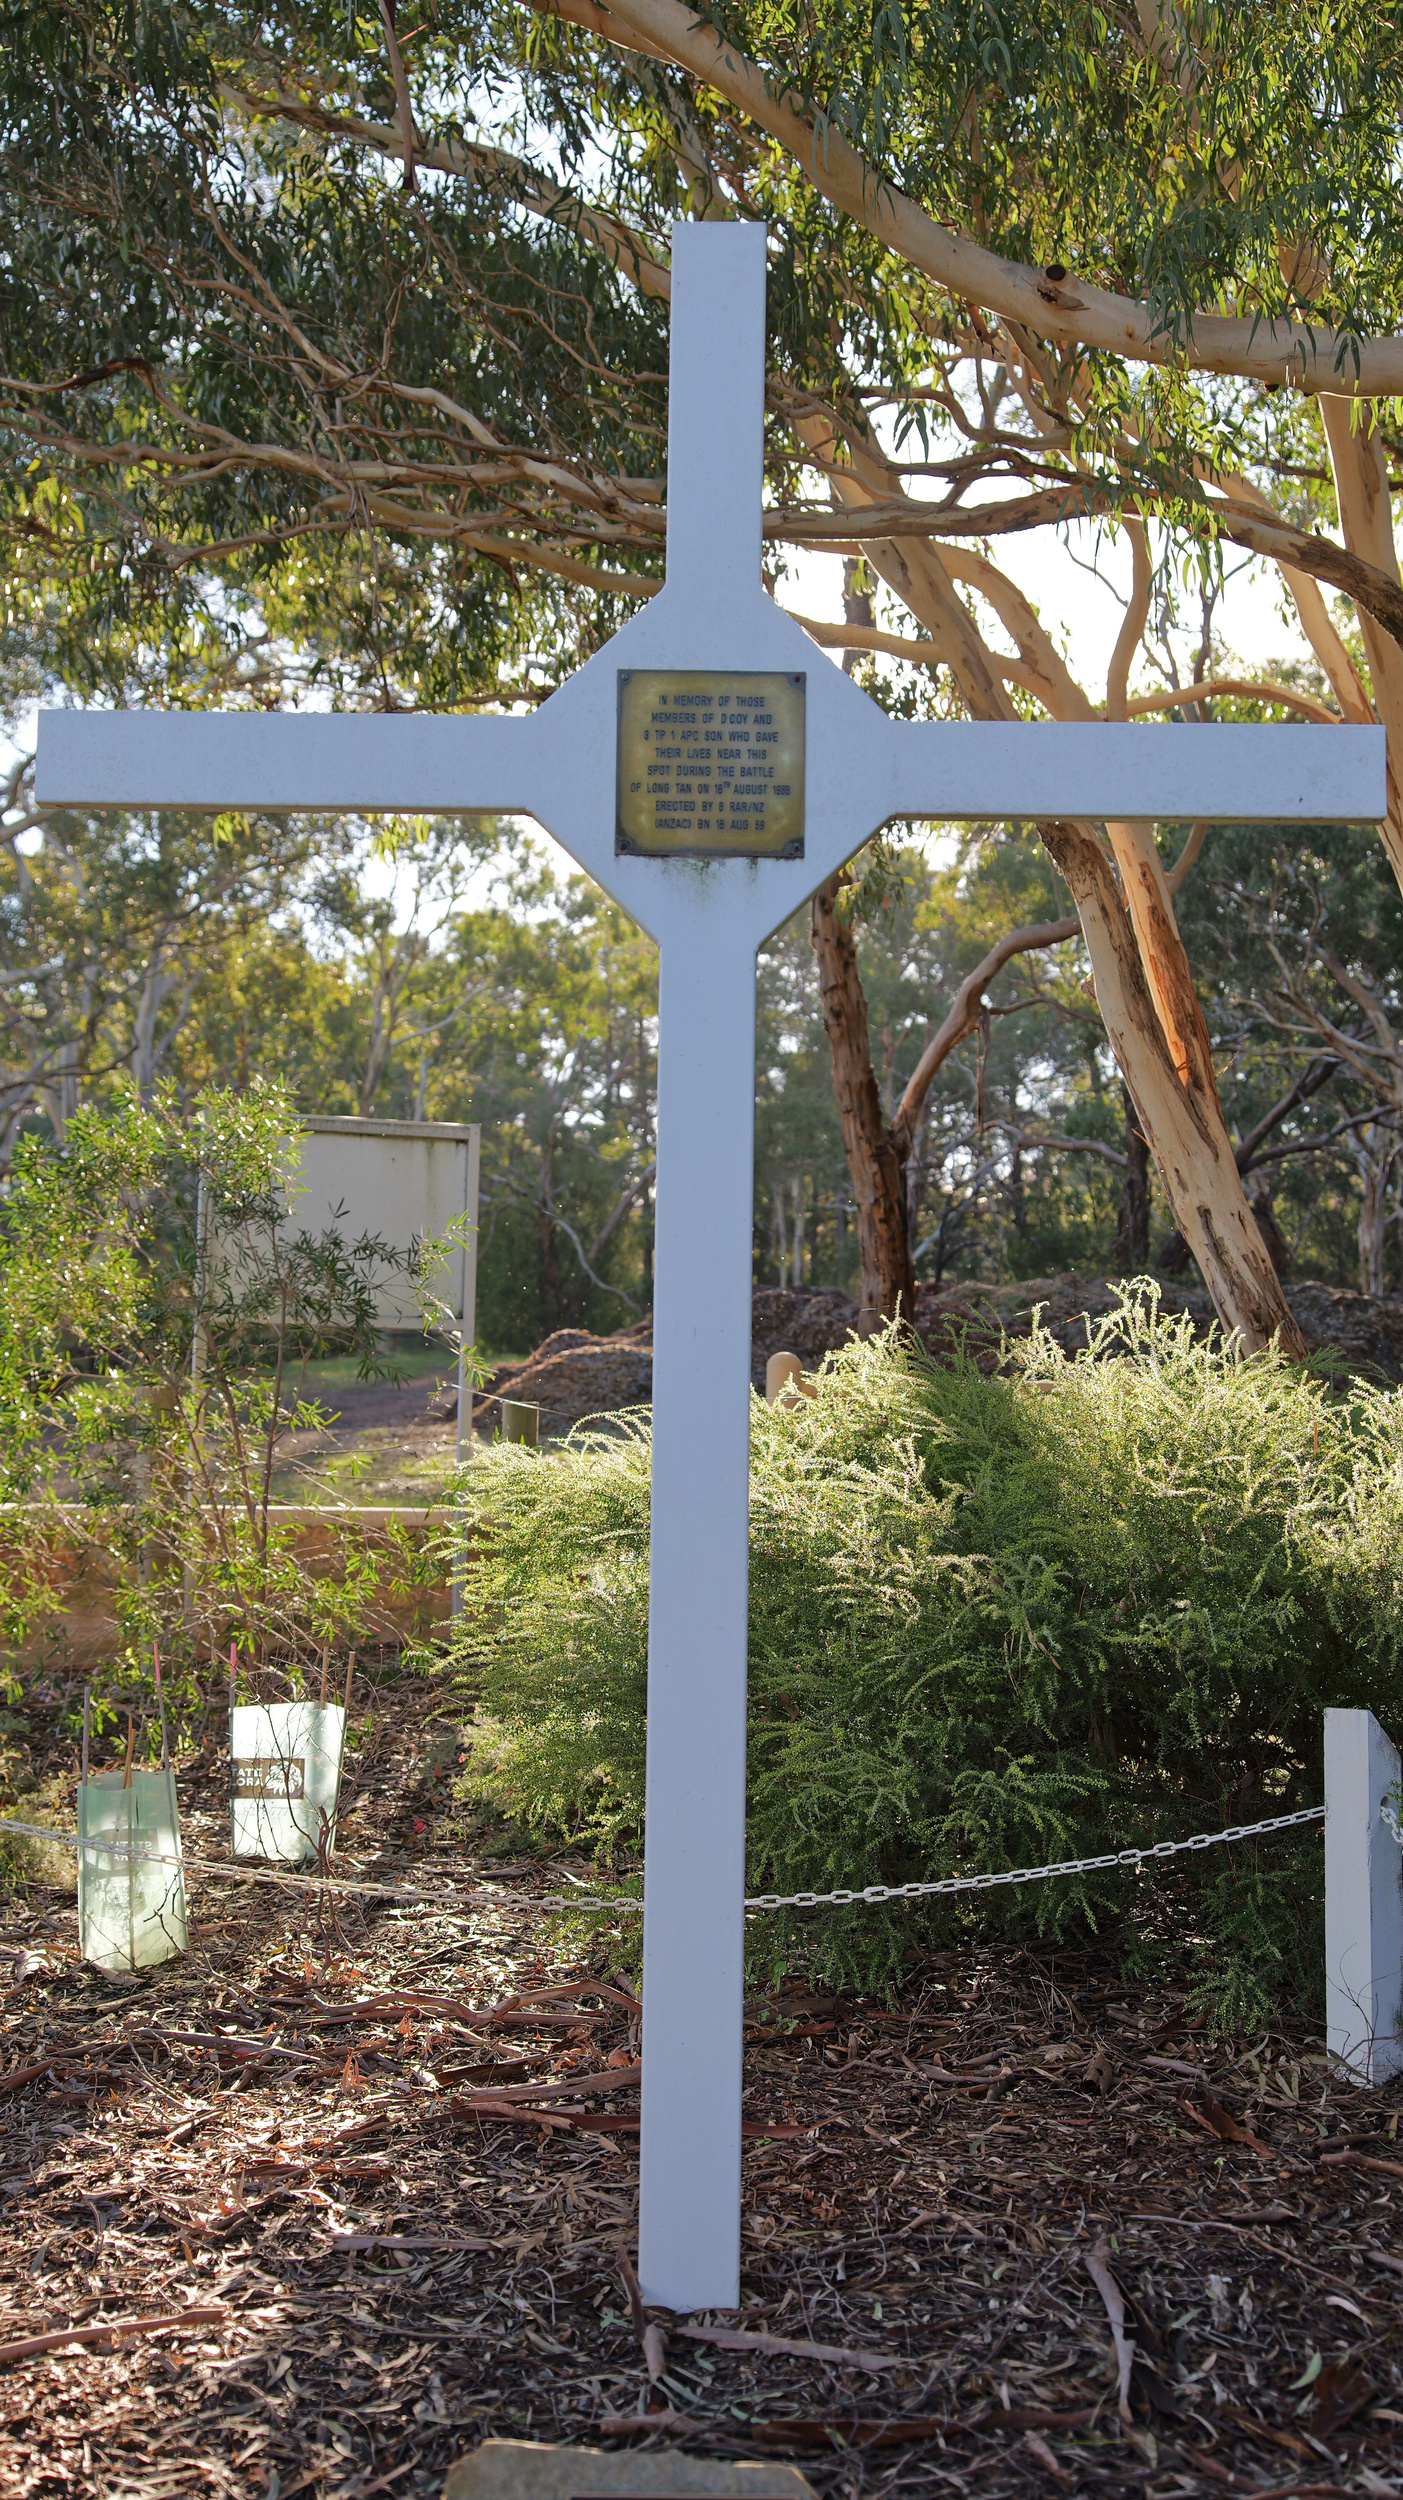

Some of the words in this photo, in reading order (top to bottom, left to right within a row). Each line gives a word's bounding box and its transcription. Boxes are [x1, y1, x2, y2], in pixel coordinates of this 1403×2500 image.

[658, 695, 668, 706] IN
[673, 695, 713, 707] MEMORY
[718, 696, 731, 707] OF
[736, 696, 766, 707] THOSE
[651, 712, 696, 724] MEMBERS
[702, 713, 714, 724] OF
[721, 713, 727, 724] D
[729, 713, 748, 725] COY
[753, 714, 773, 725] AND
[643, 729, 650, 741] 3
[655, 730, 666, 741] TP
[671, 730, 676, 741] 1
[680, 730, 699, 742] APC
[704, 730, 723, 742] SQN
[728, 731, 750, 742] WHO
[755, 731, 779, 743] GAVE
[655, 747, 681, 759] THEIR
[687, 748, 711, 759] LIVES
[717, 748, 742, 760] NEAR
[747, 749, 768, 760] THIS
[647, 765, 671, 776] SPOT
[676, 765, 711, 777] DURING
[717, 766, 735, 777] THE
[740, 766, 775, 778] BATTLE
[630, 782, 641, 793] OF
[647, 782, 670, 793] LONG
[675, 783, 692, 794] TAN
[697, 783, 710, 794] ON
[733, 784, 768, 795] AUGUST
[772, 784, 791, 796] 1966
[655, 800, 696, 812] ERECTED
[702, 801, 714, 812] BY
[718, 801, 724, 812] 6
[729, 801, 765, 813] RAR/NZ
[655, 818, 692, 829] (ANZAC)
[697, 818, 710, 829] BN
[730, 819, 749, 830] AUG
[755, 819, 765, 830] 69
[230, 1768, 263, 1777] TATE
